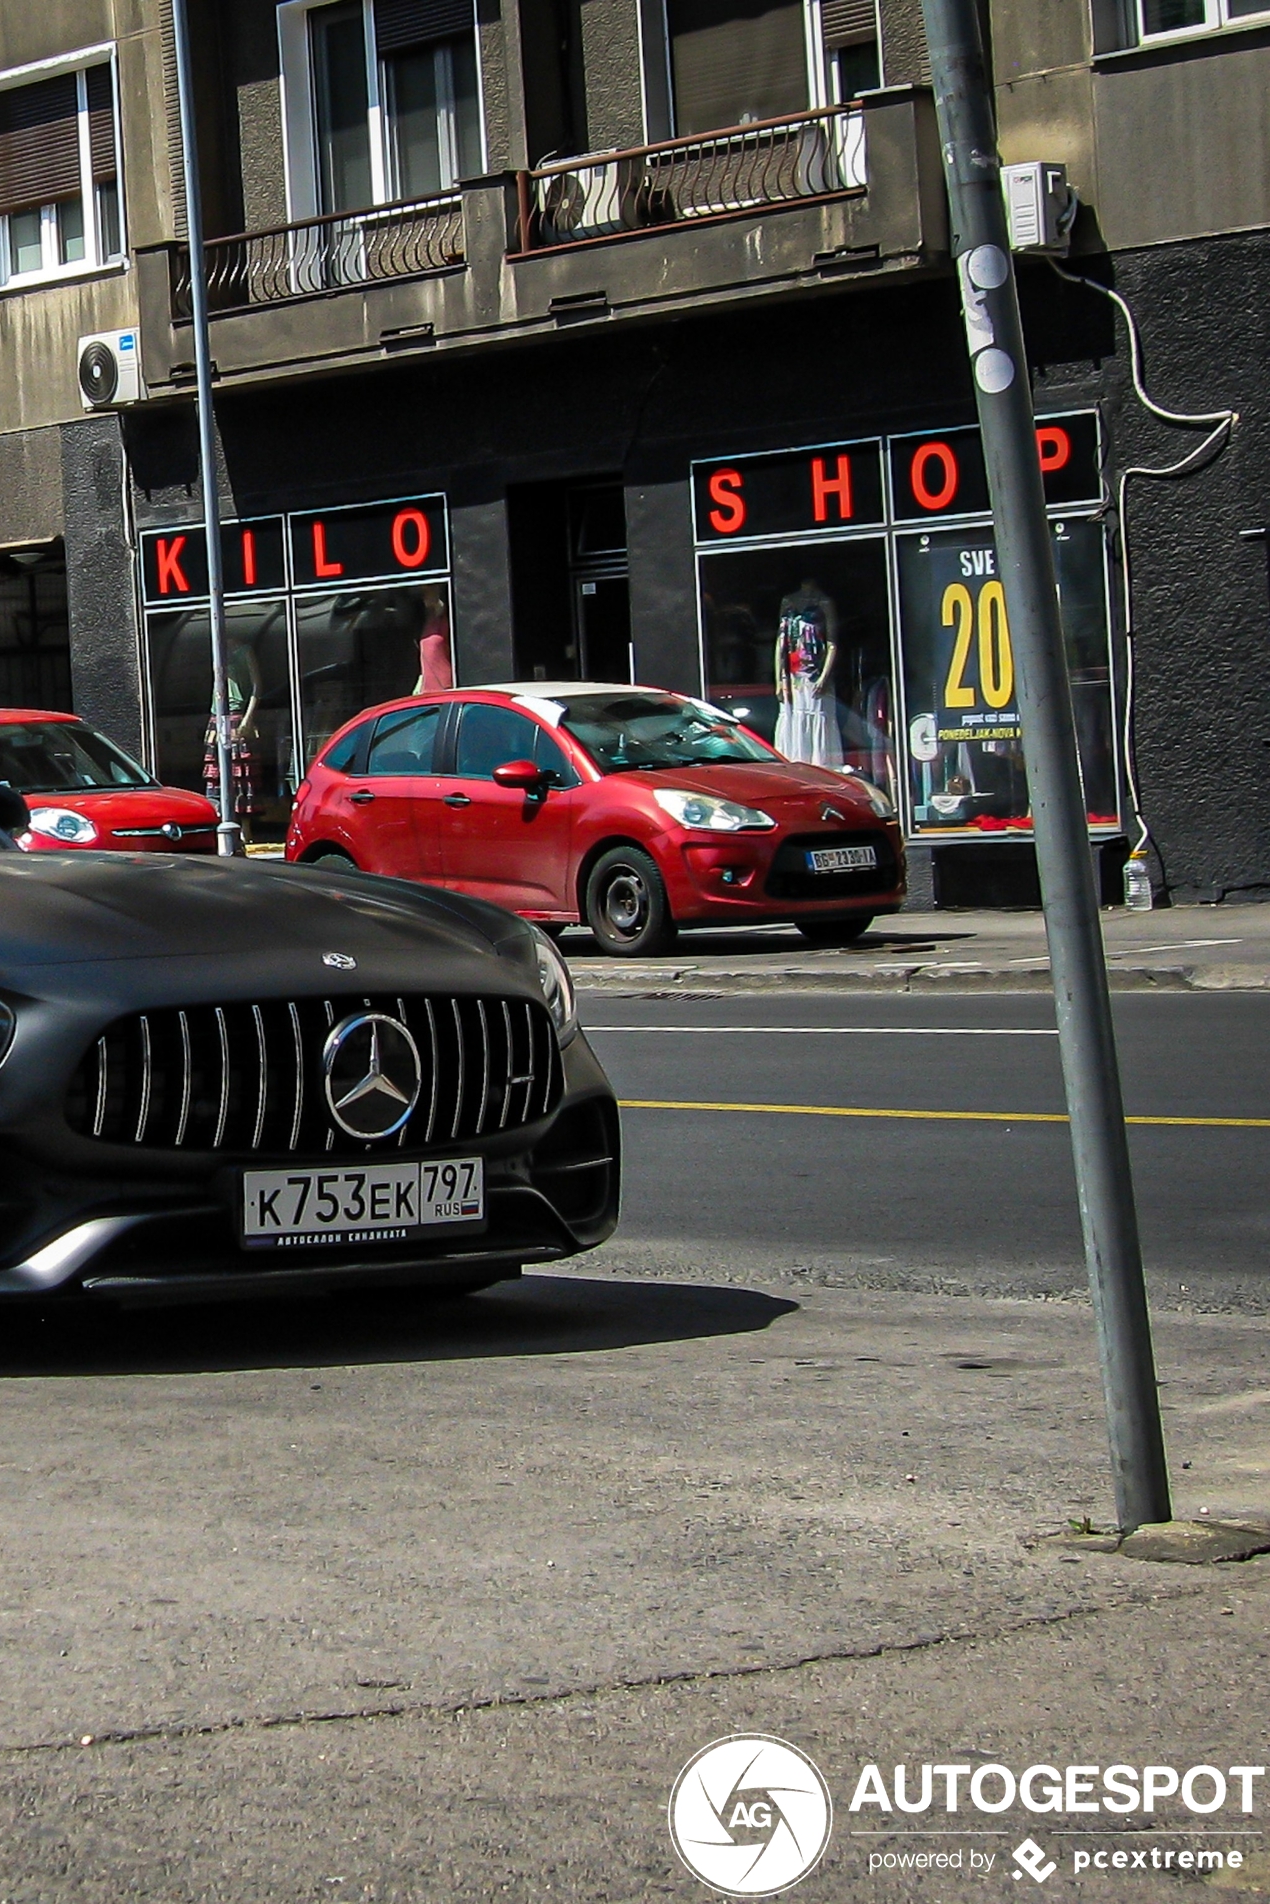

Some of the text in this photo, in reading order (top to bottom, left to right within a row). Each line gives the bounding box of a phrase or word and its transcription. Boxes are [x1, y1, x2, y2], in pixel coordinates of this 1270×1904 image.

[156, 508, 429, 594] KILO
[959, 550, 995, 577] SVE
[942, 580, 1014, 709] 20
[423, 1163, 475, 1202] 797
[434, 1202, 460, 1217] RUS
